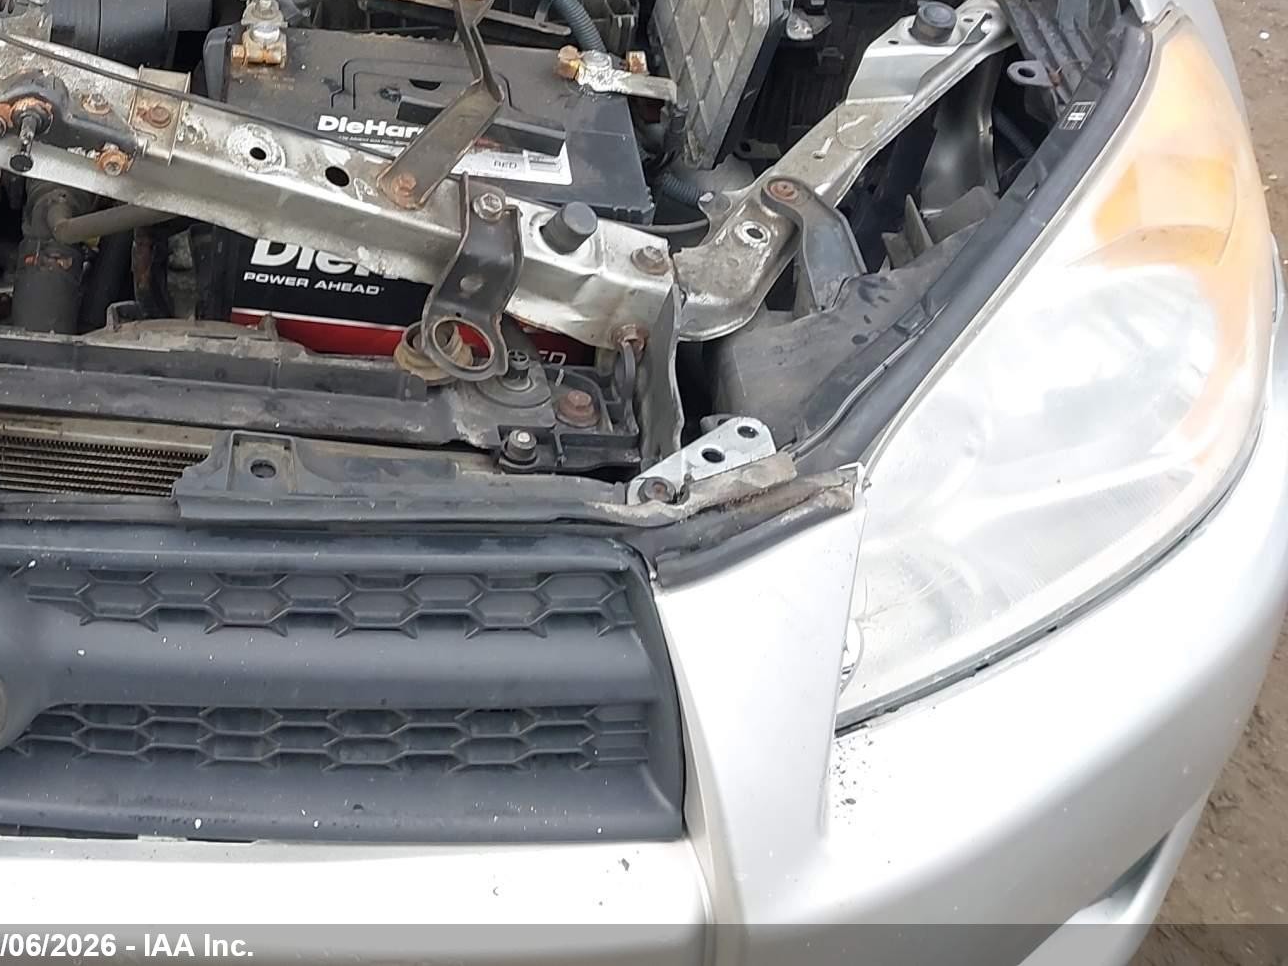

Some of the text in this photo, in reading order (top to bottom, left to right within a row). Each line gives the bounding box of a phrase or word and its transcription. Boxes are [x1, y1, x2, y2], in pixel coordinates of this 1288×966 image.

[316, 115, 425, 138] DieHar
[243, 272, 380, 295] POWER AHEAD
